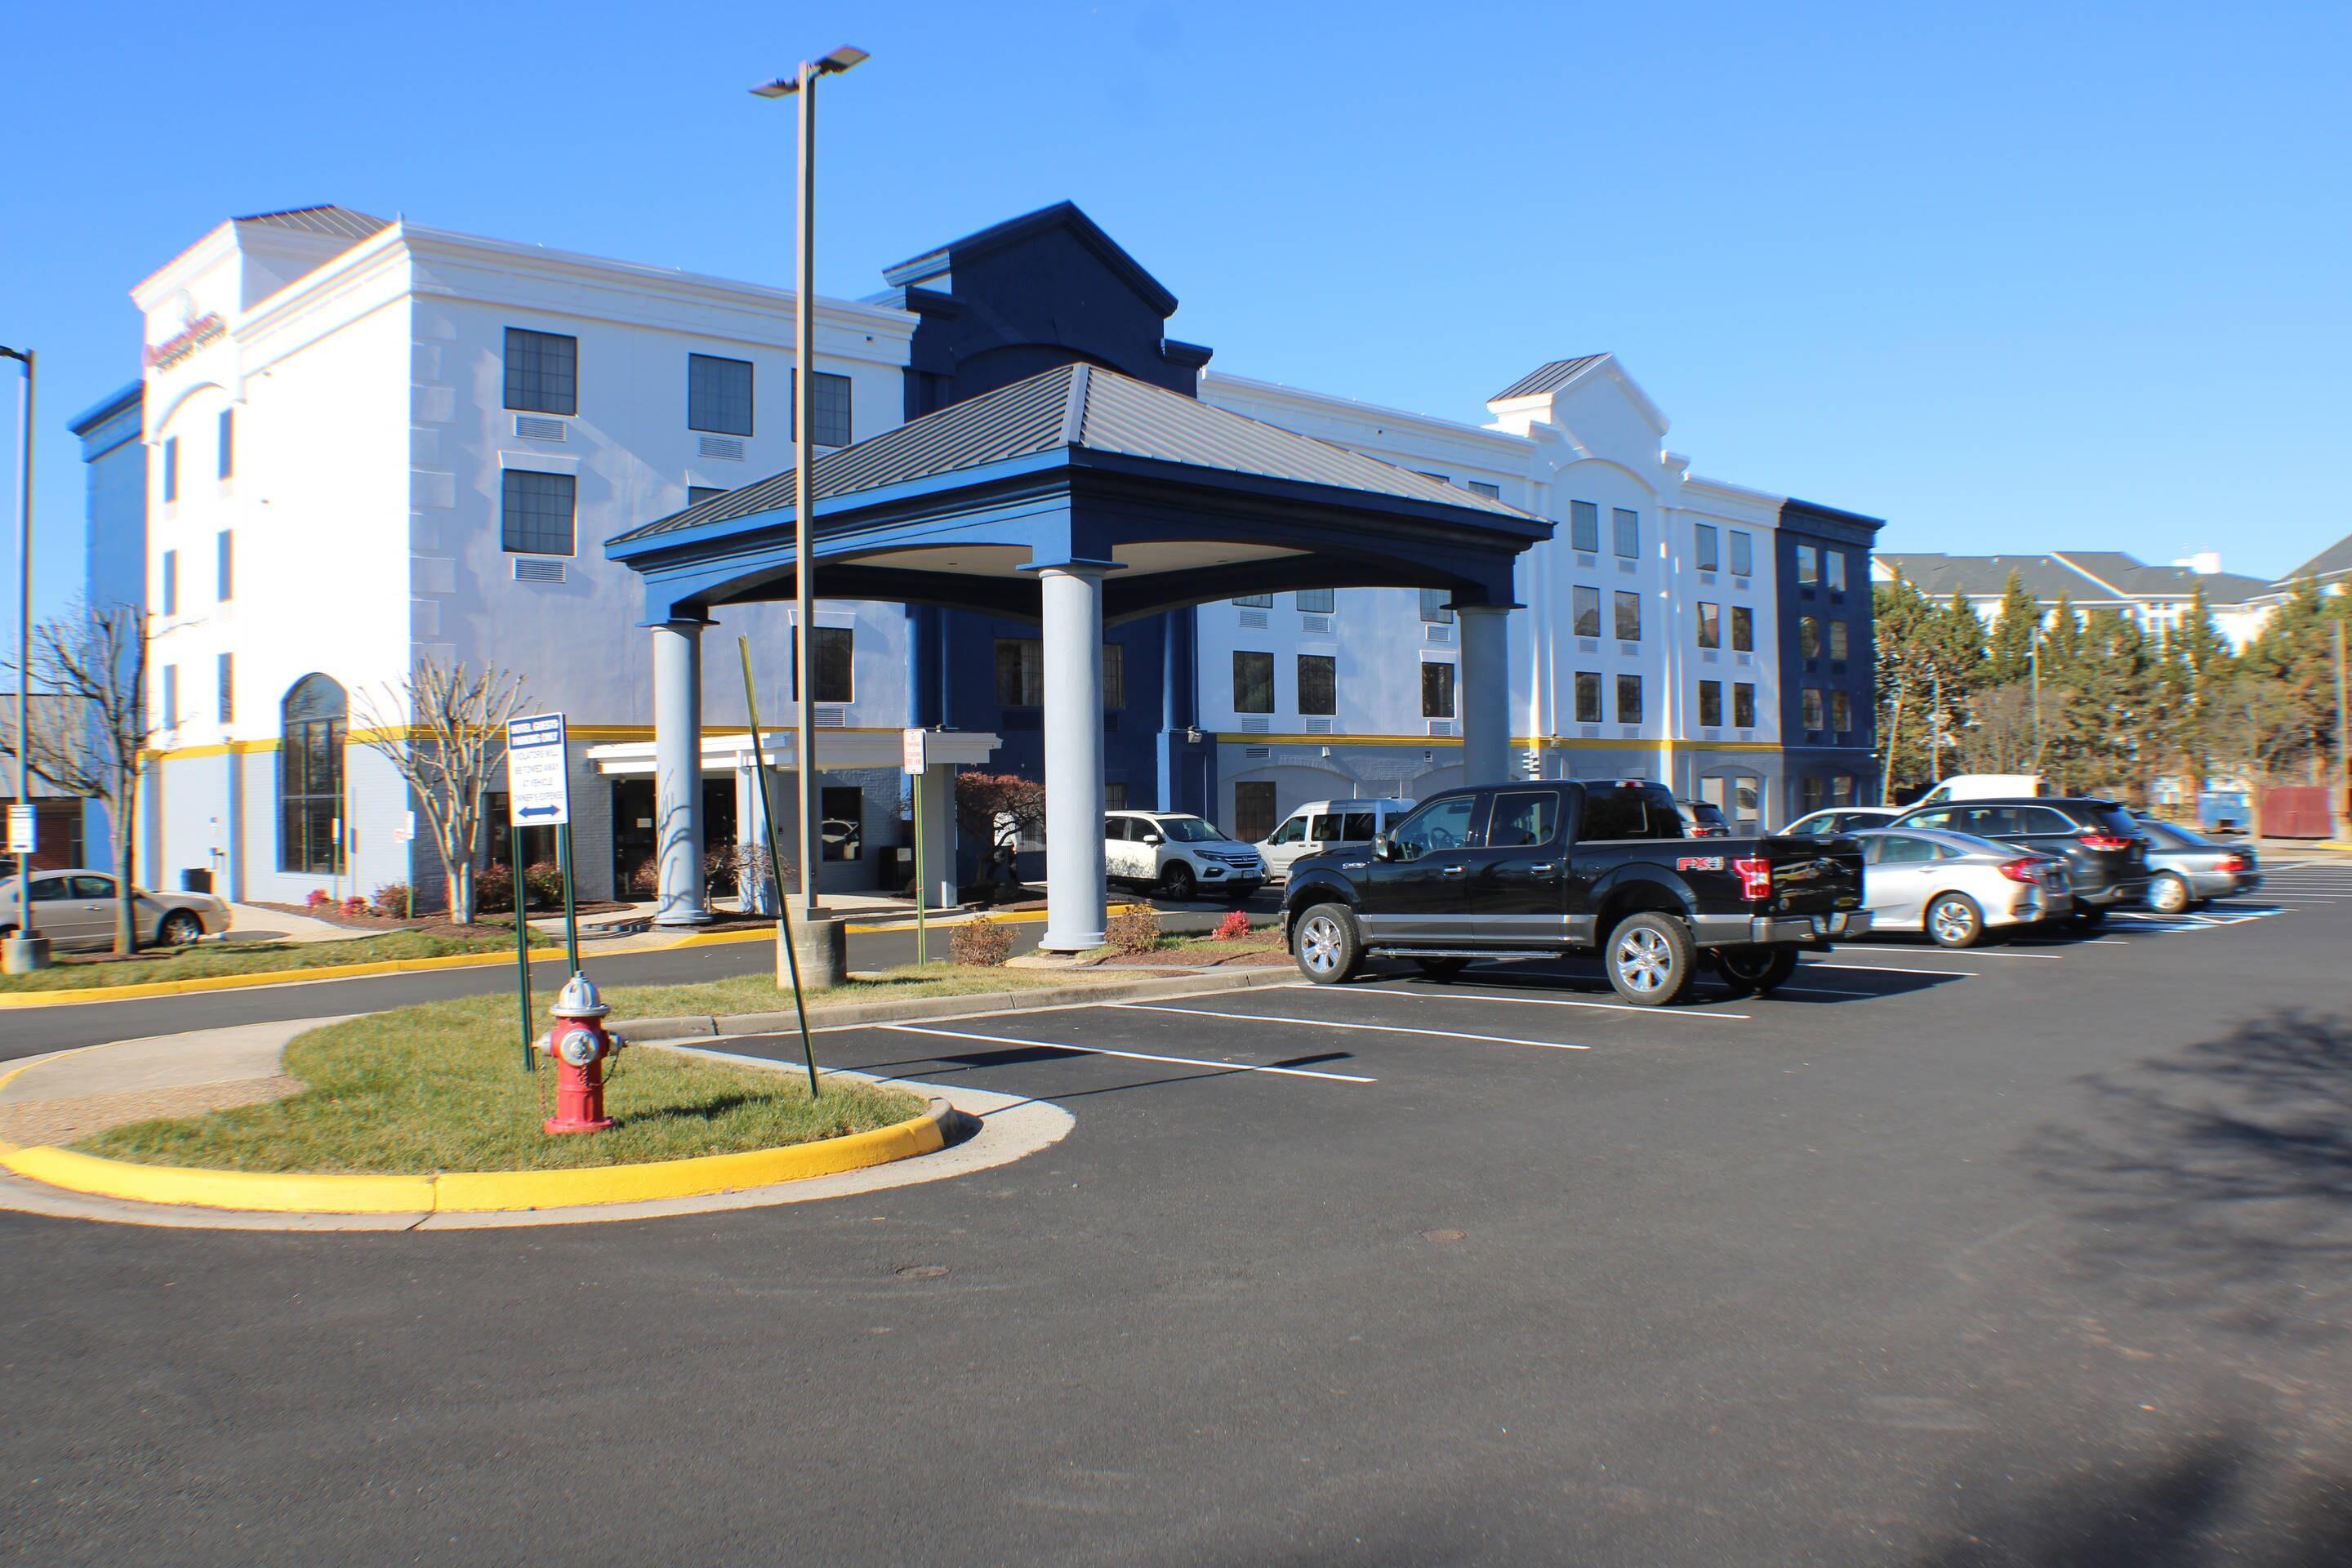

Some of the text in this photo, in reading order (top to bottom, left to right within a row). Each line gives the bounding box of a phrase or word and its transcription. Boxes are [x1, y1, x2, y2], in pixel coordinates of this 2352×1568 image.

[514, 751, 544, 760] VIOLATORS
[515, 763, 559, 774] BE TOWED AWAY
[1677, 857, 1725, 871] FX4
